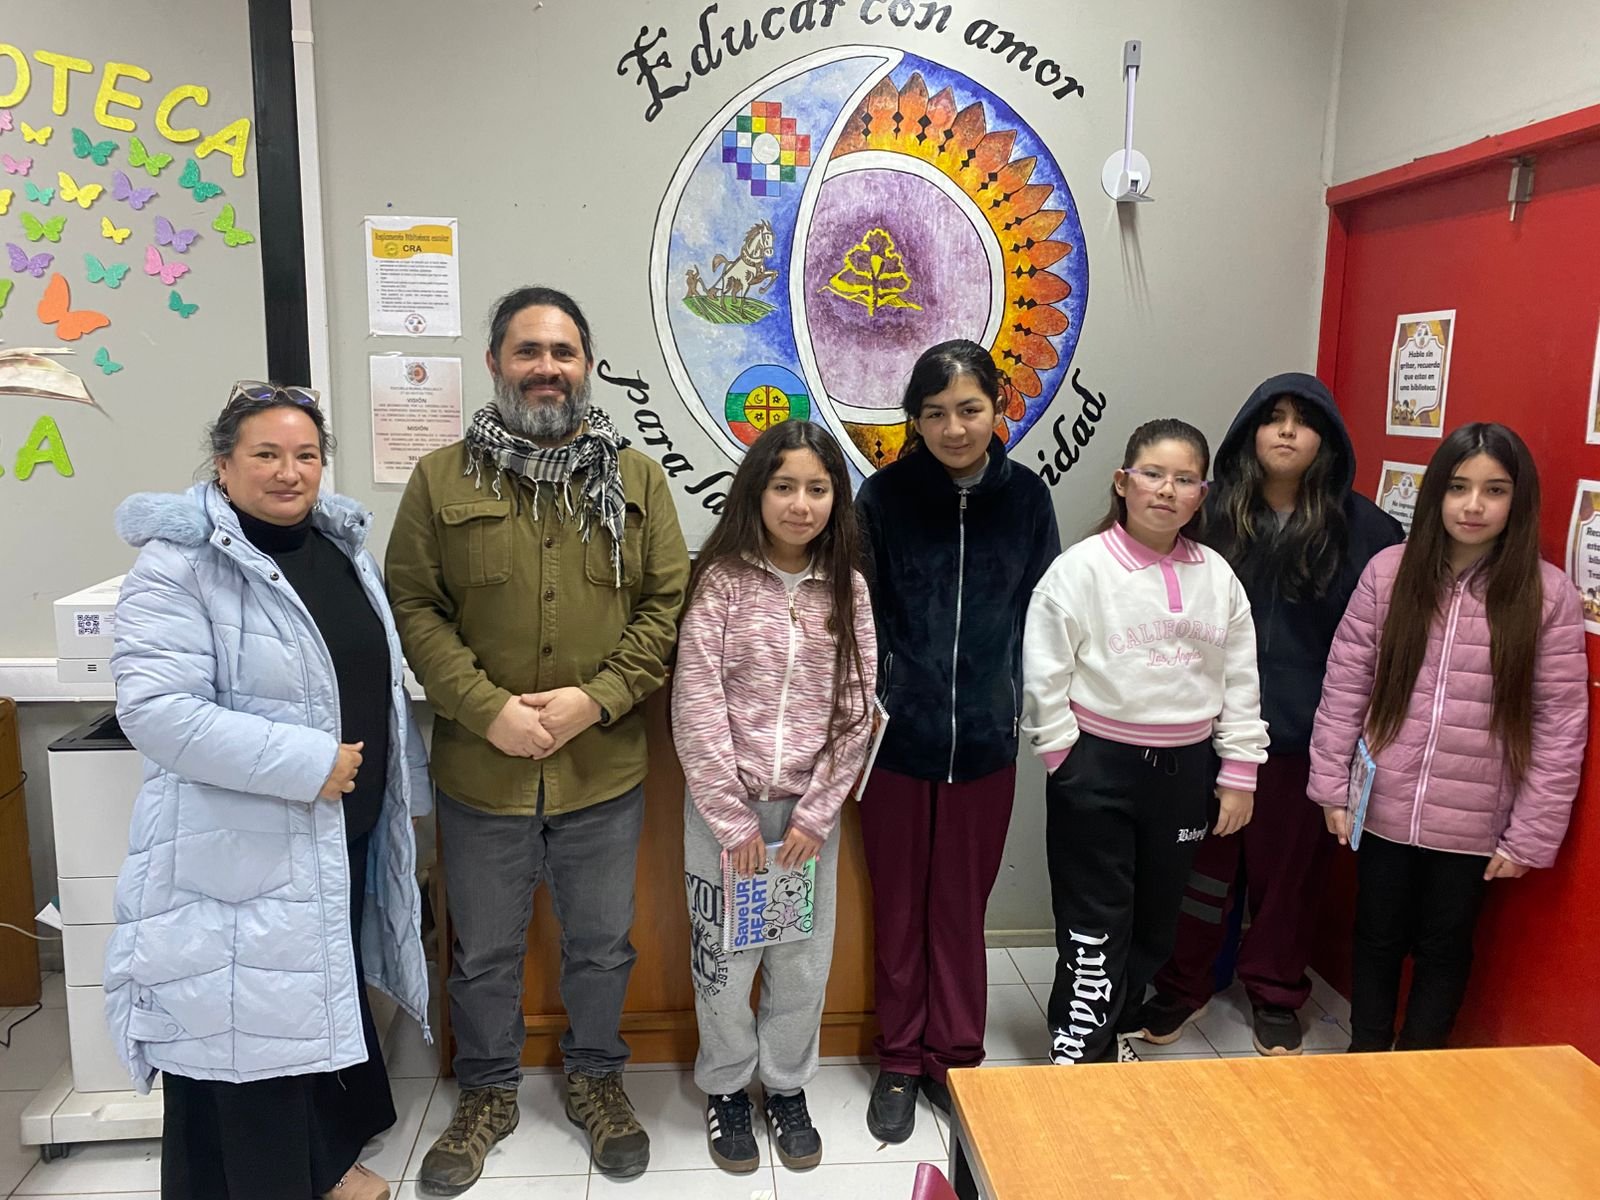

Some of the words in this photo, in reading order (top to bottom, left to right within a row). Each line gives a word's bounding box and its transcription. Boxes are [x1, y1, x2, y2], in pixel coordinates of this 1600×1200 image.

[617, 0, 845, 122] Educar
[860, 0, 952, 33] con
[964, 19, 1084, 100] amor
[402, 244, 422, 253] CRA
[1400, 362, 1416, 370] gritar,
[1417, 361, 1440, 369] recuerda
[1408, 350, 1425, 358] Habla
[1426, 350, 1434, 358] sin
[597, 359, 694, 478] para
[1109, 618, 1228, 655] CALIFORNI
[685, 871, 723, 928] YO
[750, 878, 768, 944] HEART
[710, 941, 728, 989] COLLEGE
[1049, 928, 1113, 1065] abygirl
